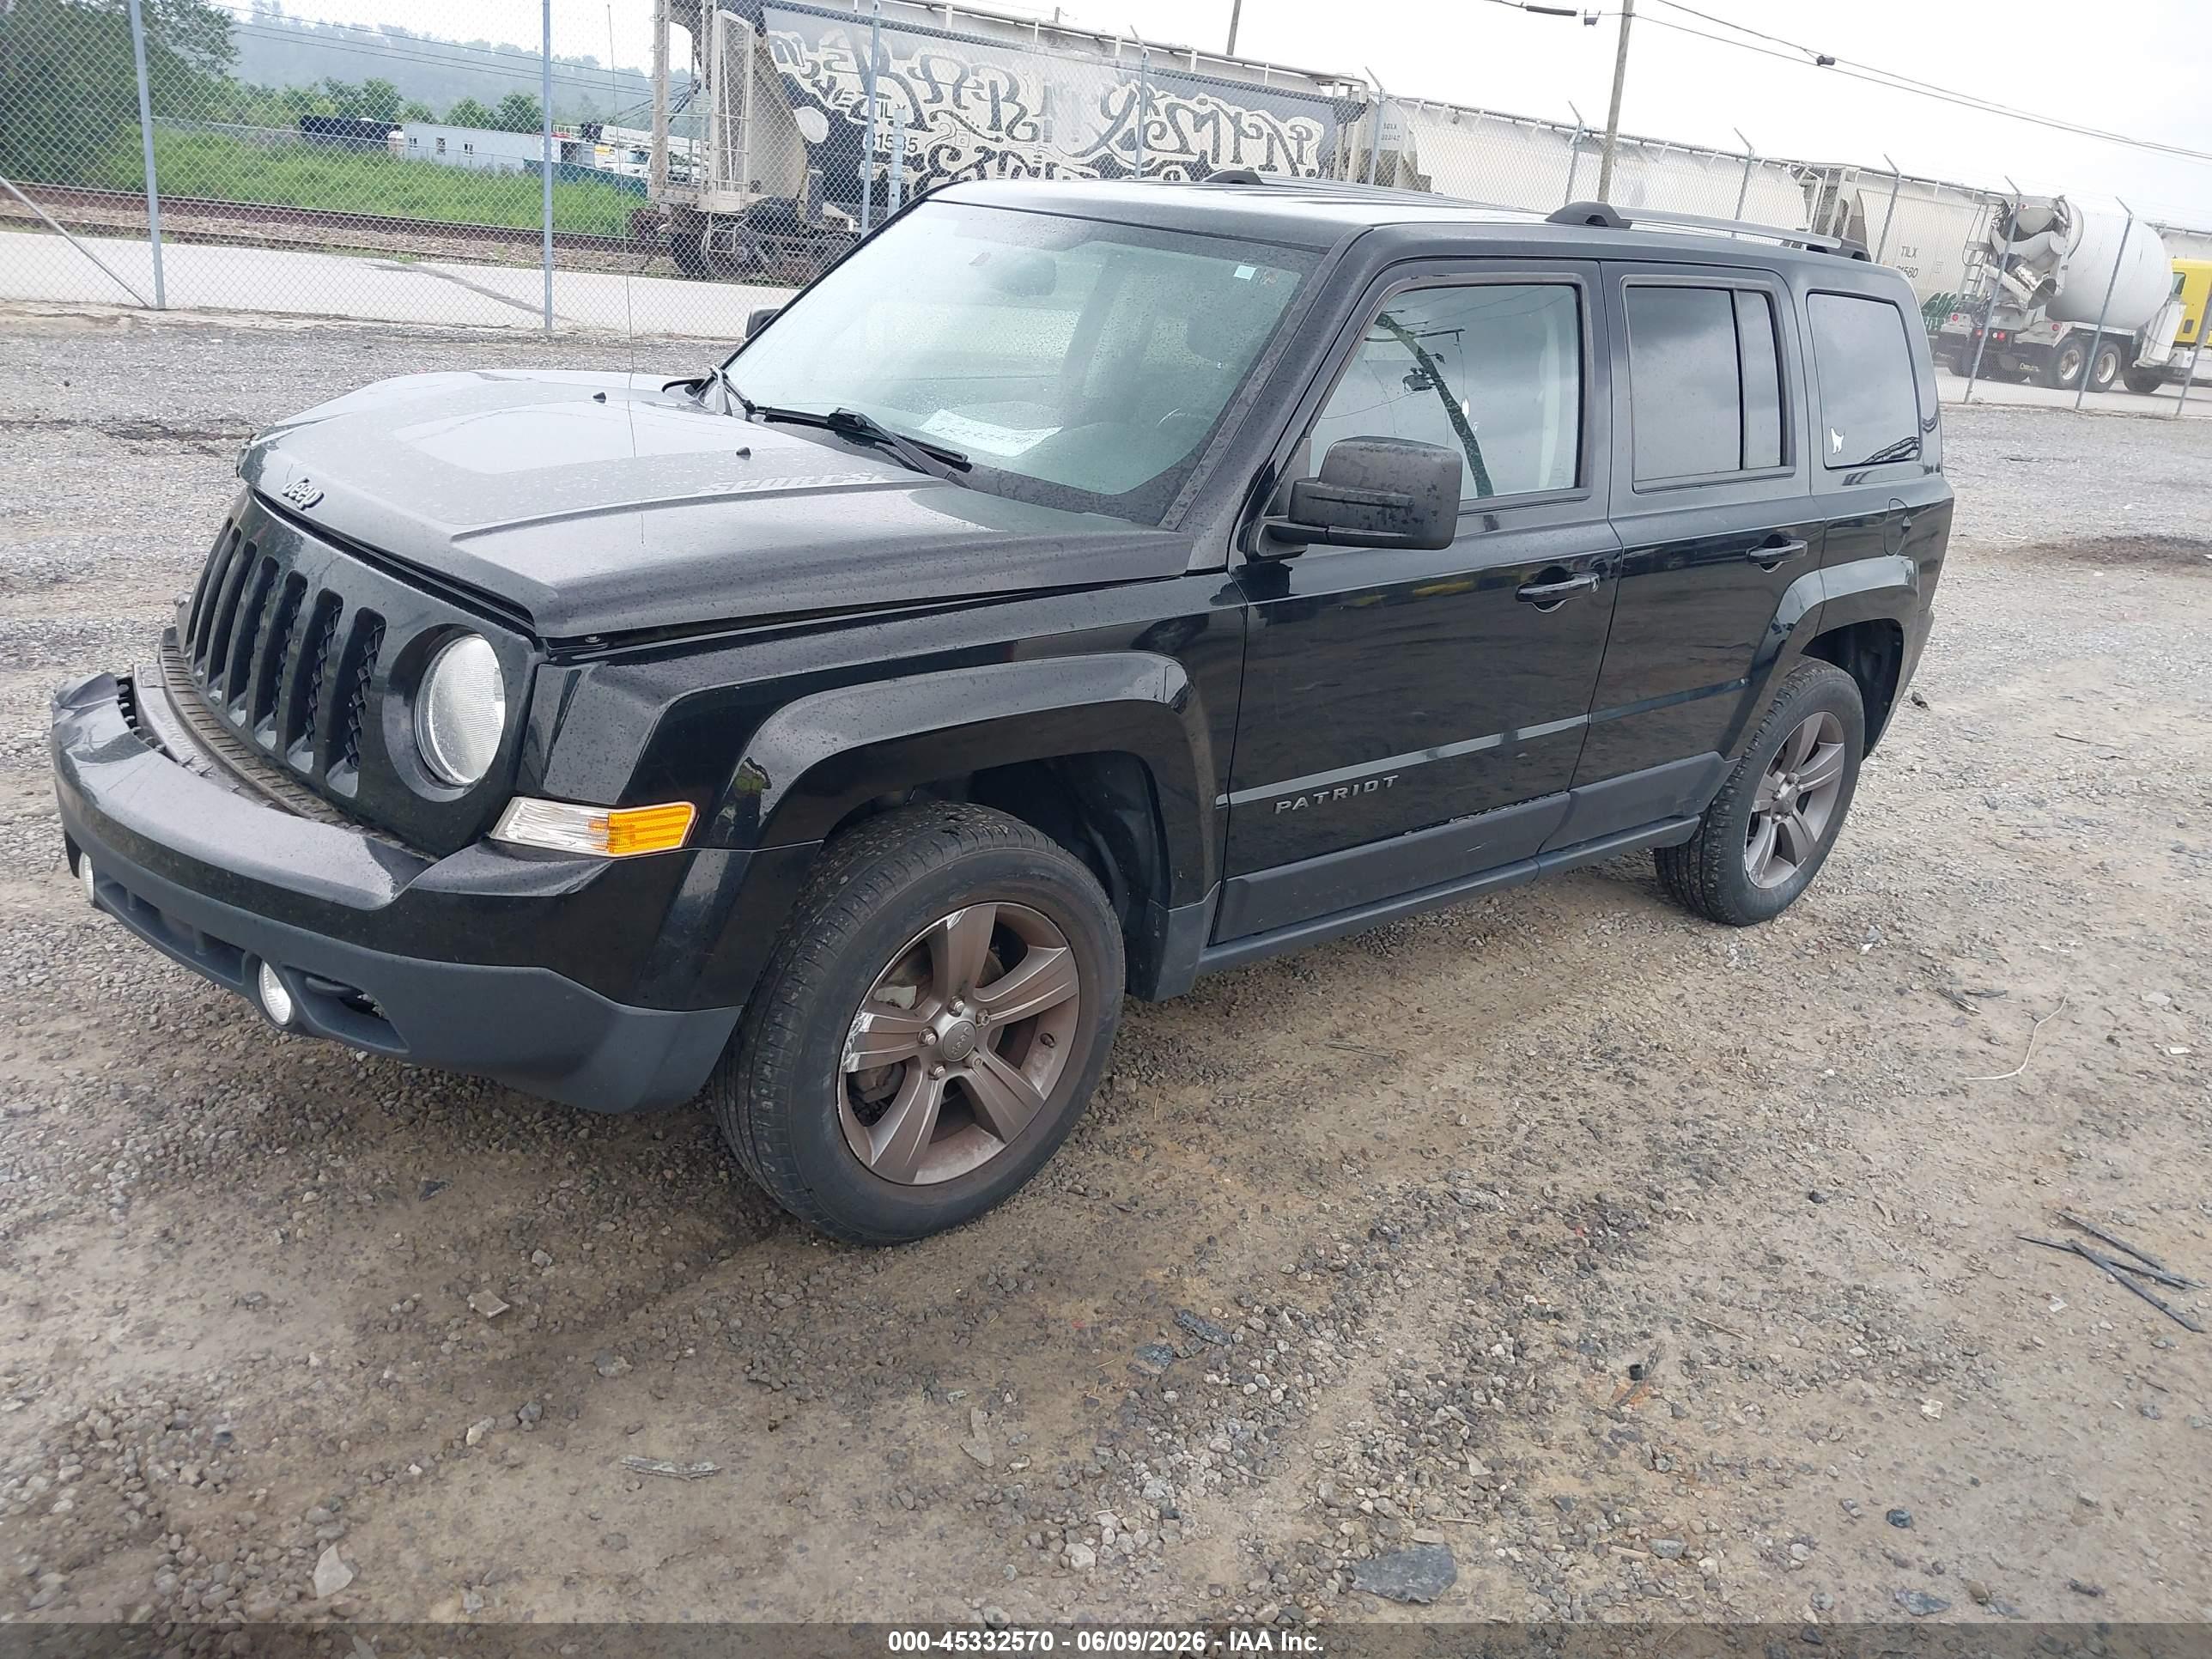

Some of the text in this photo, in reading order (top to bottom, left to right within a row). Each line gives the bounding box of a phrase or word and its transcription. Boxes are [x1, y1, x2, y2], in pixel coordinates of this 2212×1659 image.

[1901, 246, 1918, 258] TILX
[282, 476, 325, 512] Jeep
[1273, 775, 1400, 815] PATRIOT
